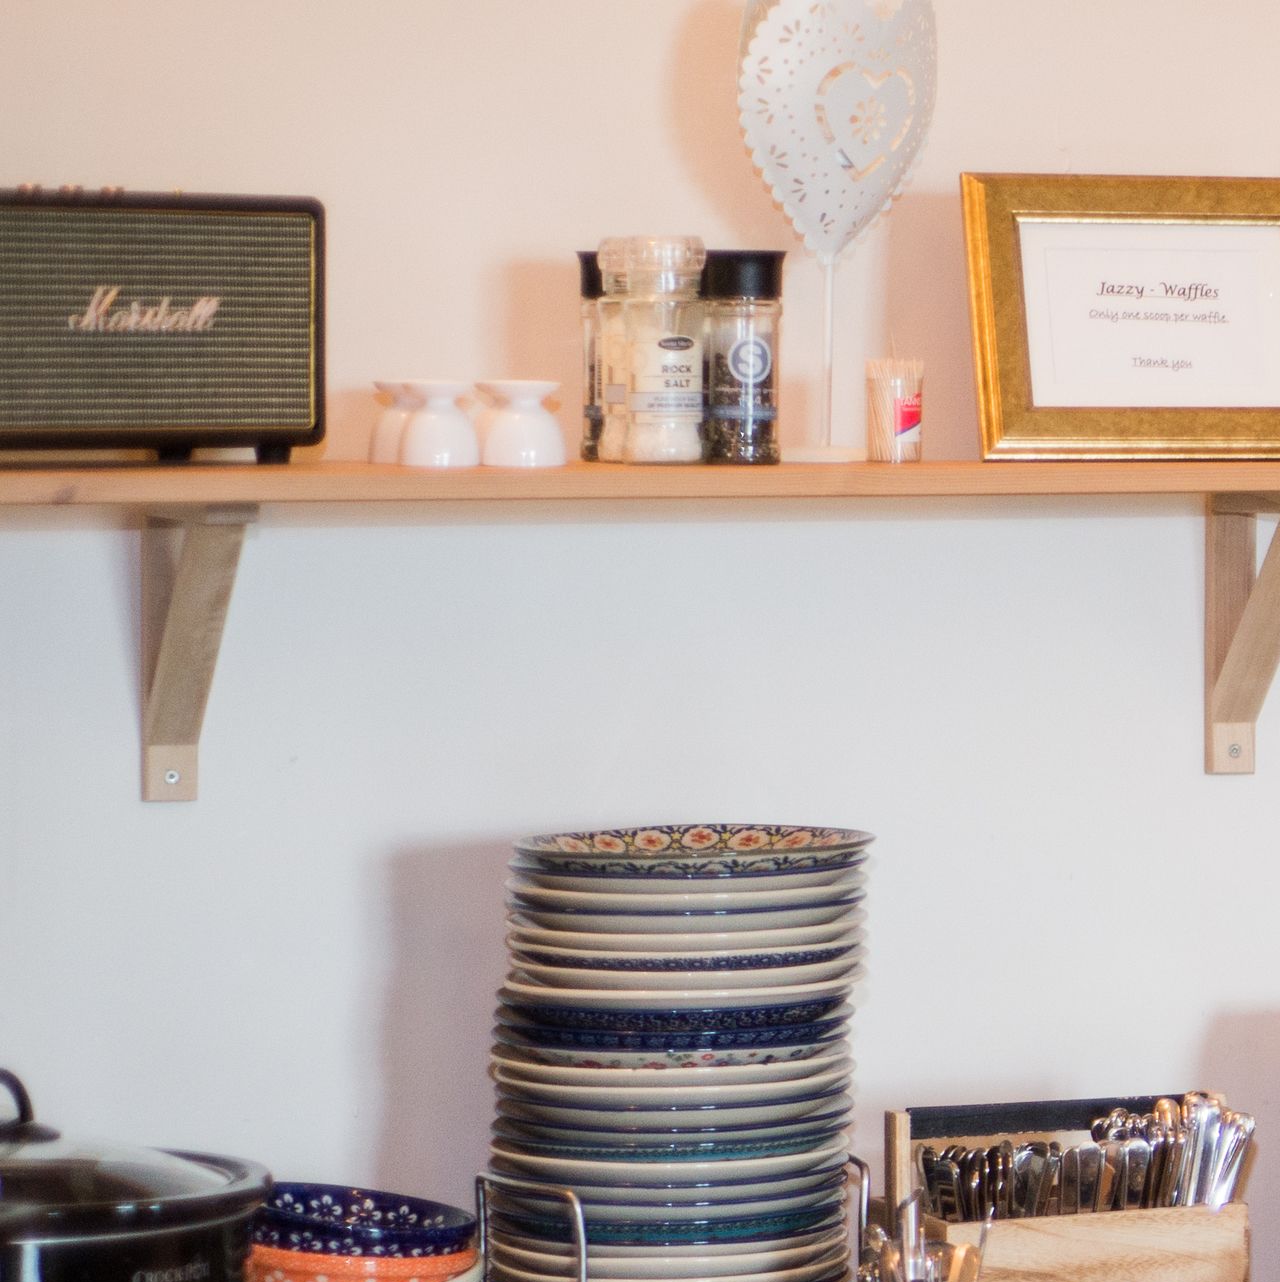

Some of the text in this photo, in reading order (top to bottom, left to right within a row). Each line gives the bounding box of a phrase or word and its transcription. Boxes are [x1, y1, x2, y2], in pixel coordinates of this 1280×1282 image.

[1096, 281, 1144, 299] Jazzy
[1159, 281, 1219, 301] Waffles
[68, 284, 222, 332] Marshall
[1088, 308, 1119, 323] Only
[1120, 311, 1142, 321] one
[1143, 311, 1171, 322] scoop
[1173, 311, 1190, 323] per
[661, 364, 692, 374] ROCK
[1131, 356, 1193, 372] Thank you
[663, 378, 690, 388] SALT
